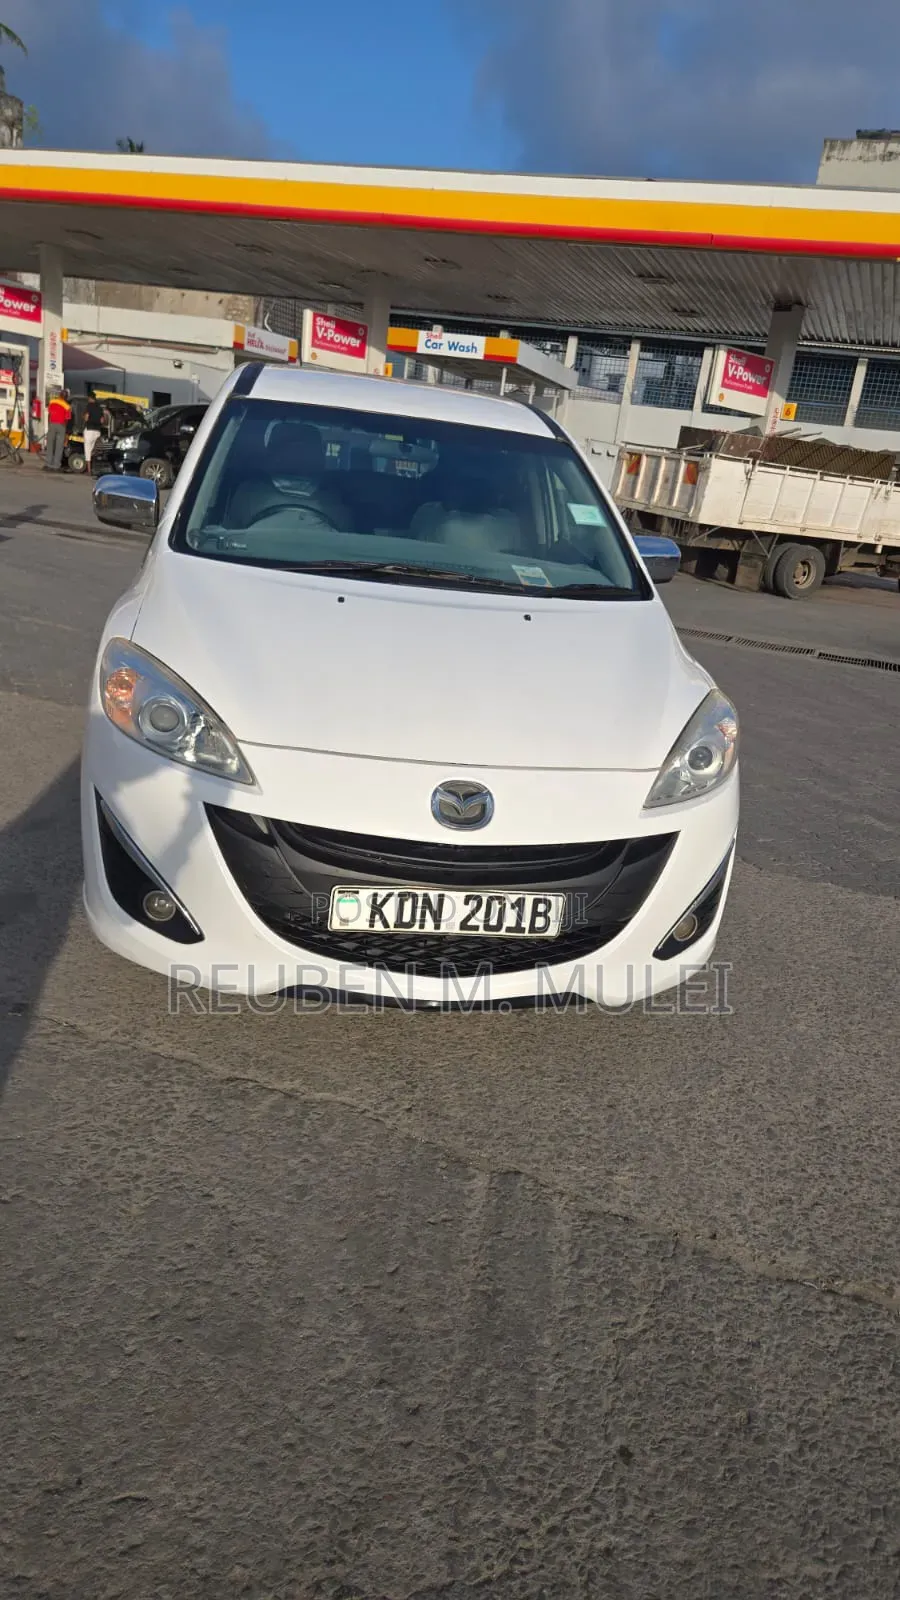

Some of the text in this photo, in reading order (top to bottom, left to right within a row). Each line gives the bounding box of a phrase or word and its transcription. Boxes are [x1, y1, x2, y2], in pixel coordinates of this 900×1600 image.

[316, 317, 336, 329] Shell
[316, 325, 361, 348] V-Power
[424, 339, 478, 353] Car Wash
[728, 353, 748, 367] Shell
[728, 362, 768, 385] V-Power
[368, 891, 553, 934] KDN 201B
